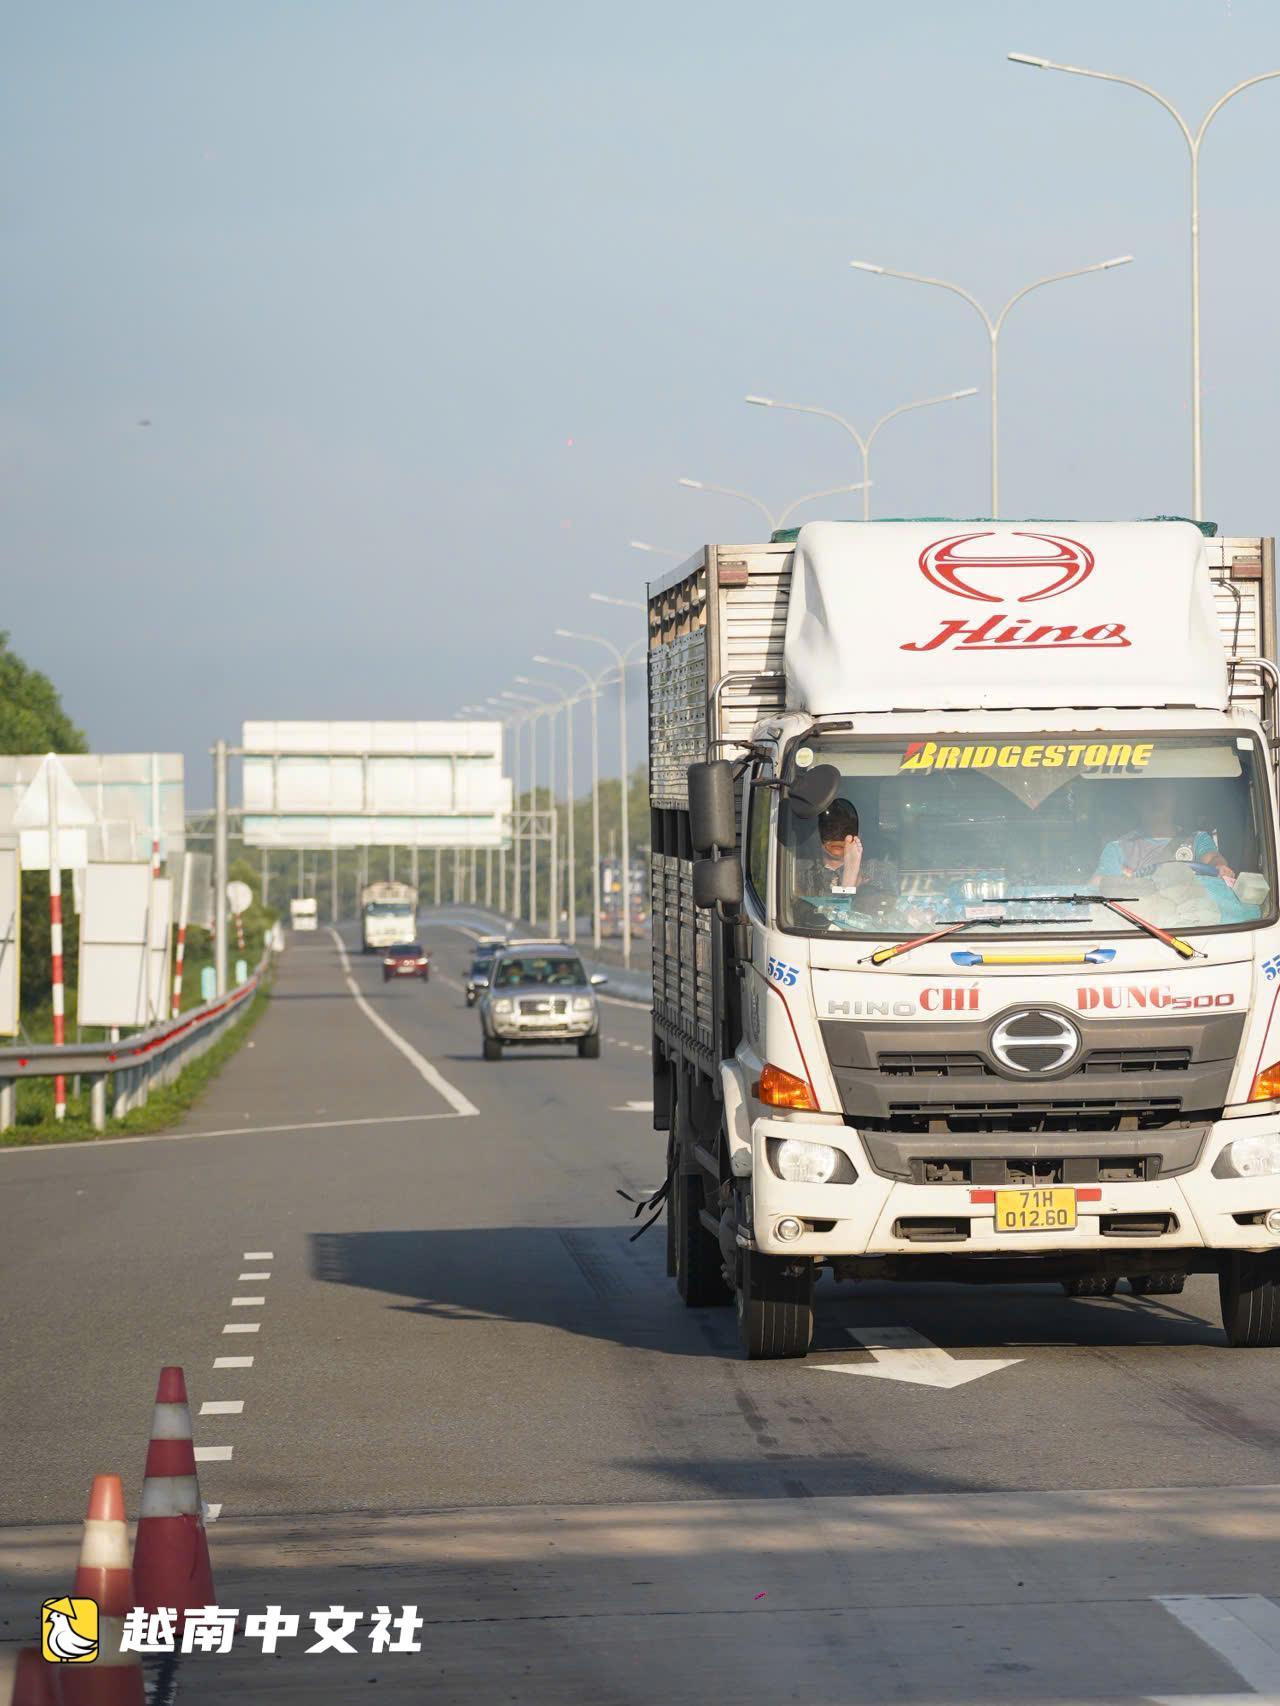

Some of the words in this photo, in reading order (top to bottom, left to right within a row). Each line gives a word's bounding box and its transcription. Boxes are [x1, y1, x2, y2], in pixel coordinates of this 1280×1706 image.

[899, 615, 1132, 651] Hino
[900, 742, 1154, 769] BRIDGESTONE
[768, 956, 799, 986] 555
[919, 982, 980, 1011] CHÍ
[1171, 993, 1235, 1010] 500
[828, 1000, 916, 1016] HINO
[1019, 1191, 1053, 1208] 71H
[1006, 1209, 1068, 1227] 012.60
